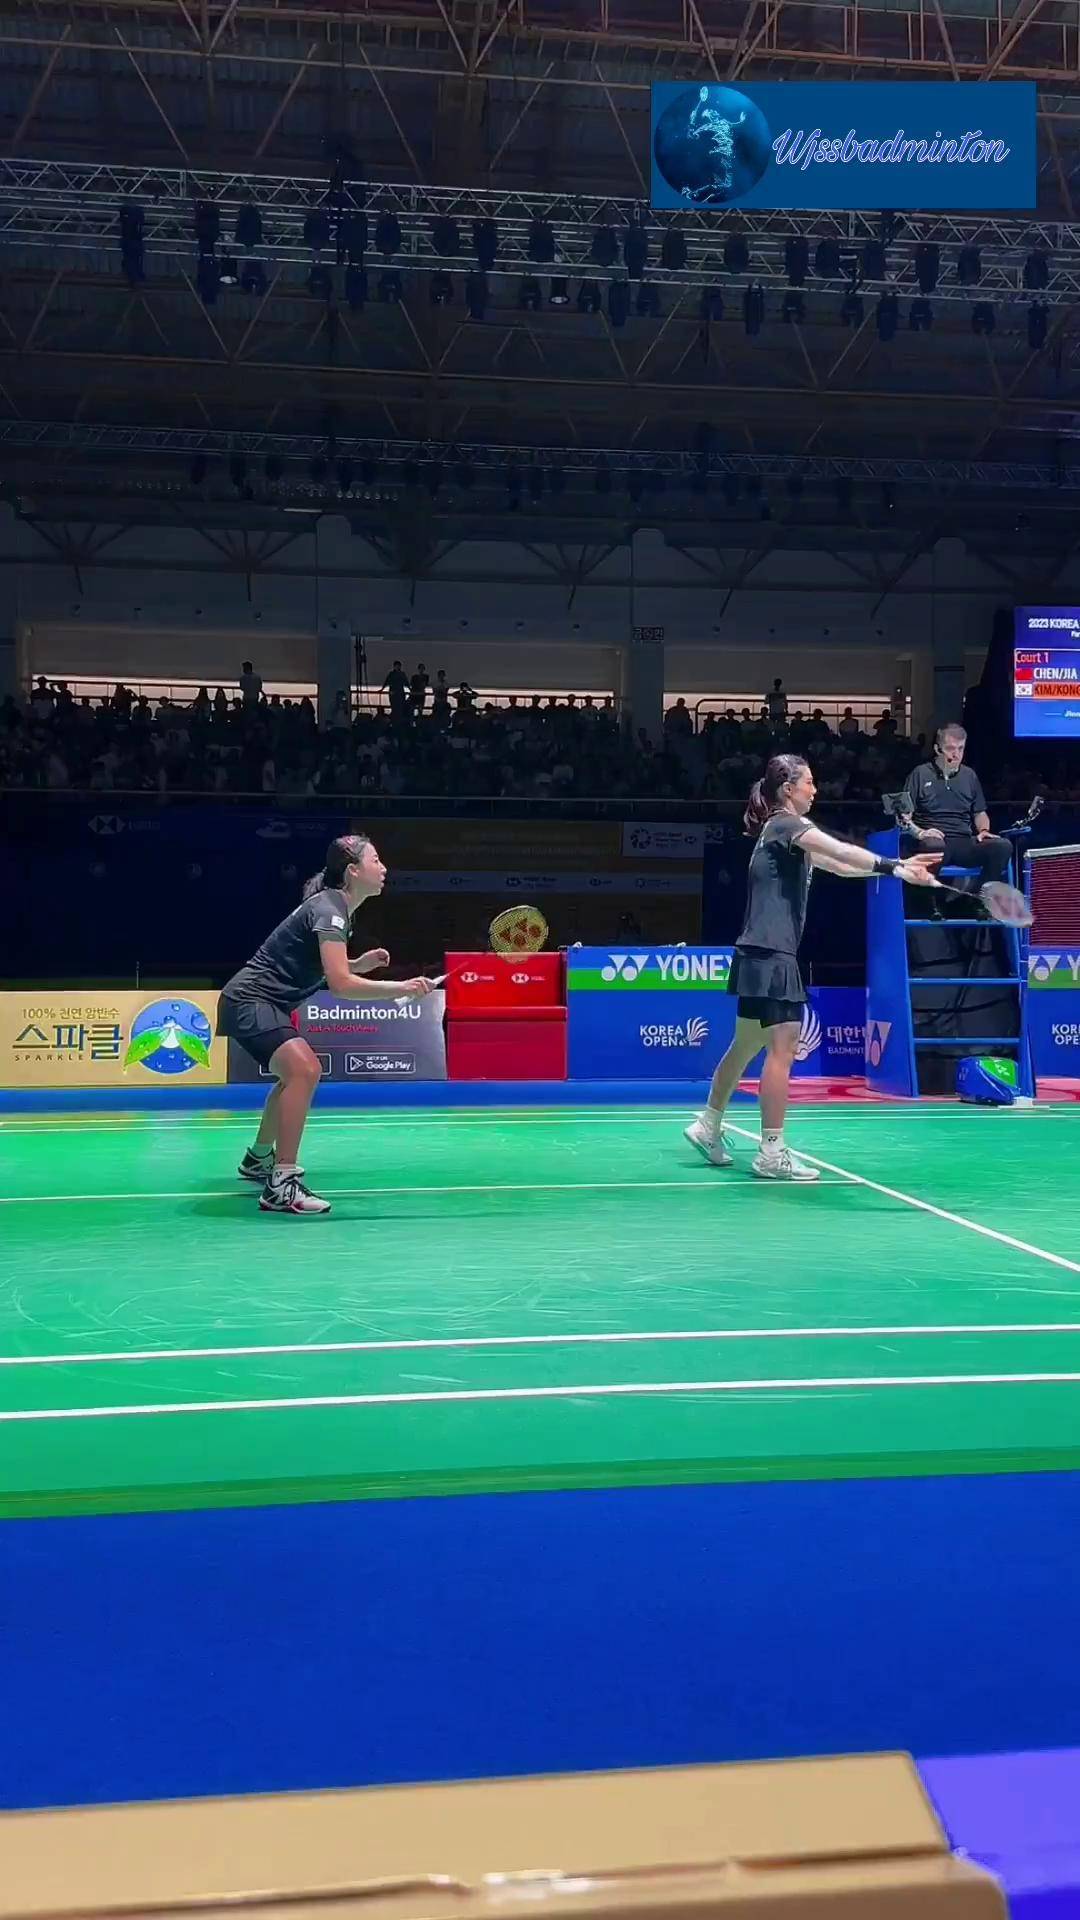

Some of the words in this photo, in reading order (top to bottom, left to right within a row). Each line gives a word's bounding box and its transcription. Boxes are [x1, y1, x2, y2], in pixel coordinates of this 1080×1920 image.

[1028, 618, 1049, 629] 2023
[1050, 618, 1080, 629] KOREA
[1016, 651, 1042, 663] Court
[1044, 652, 1049, 663] 1
[1033, 667, 1078, 679] CHEN/JIA
[22, 1008, 56, 1019] 100%
[307, 1005, 421, 1020] Badminton4U
[640, 1025, 684, 1036] KOREA
[12, 1023, 124, 1060] 스파클
[643, 1036, 678, 1047] OPEN
[1054, 1035, 1080, 1046] OPE
[366, 1061, 394, 1071] Google
[395, 1061, 411, 1071] Play
